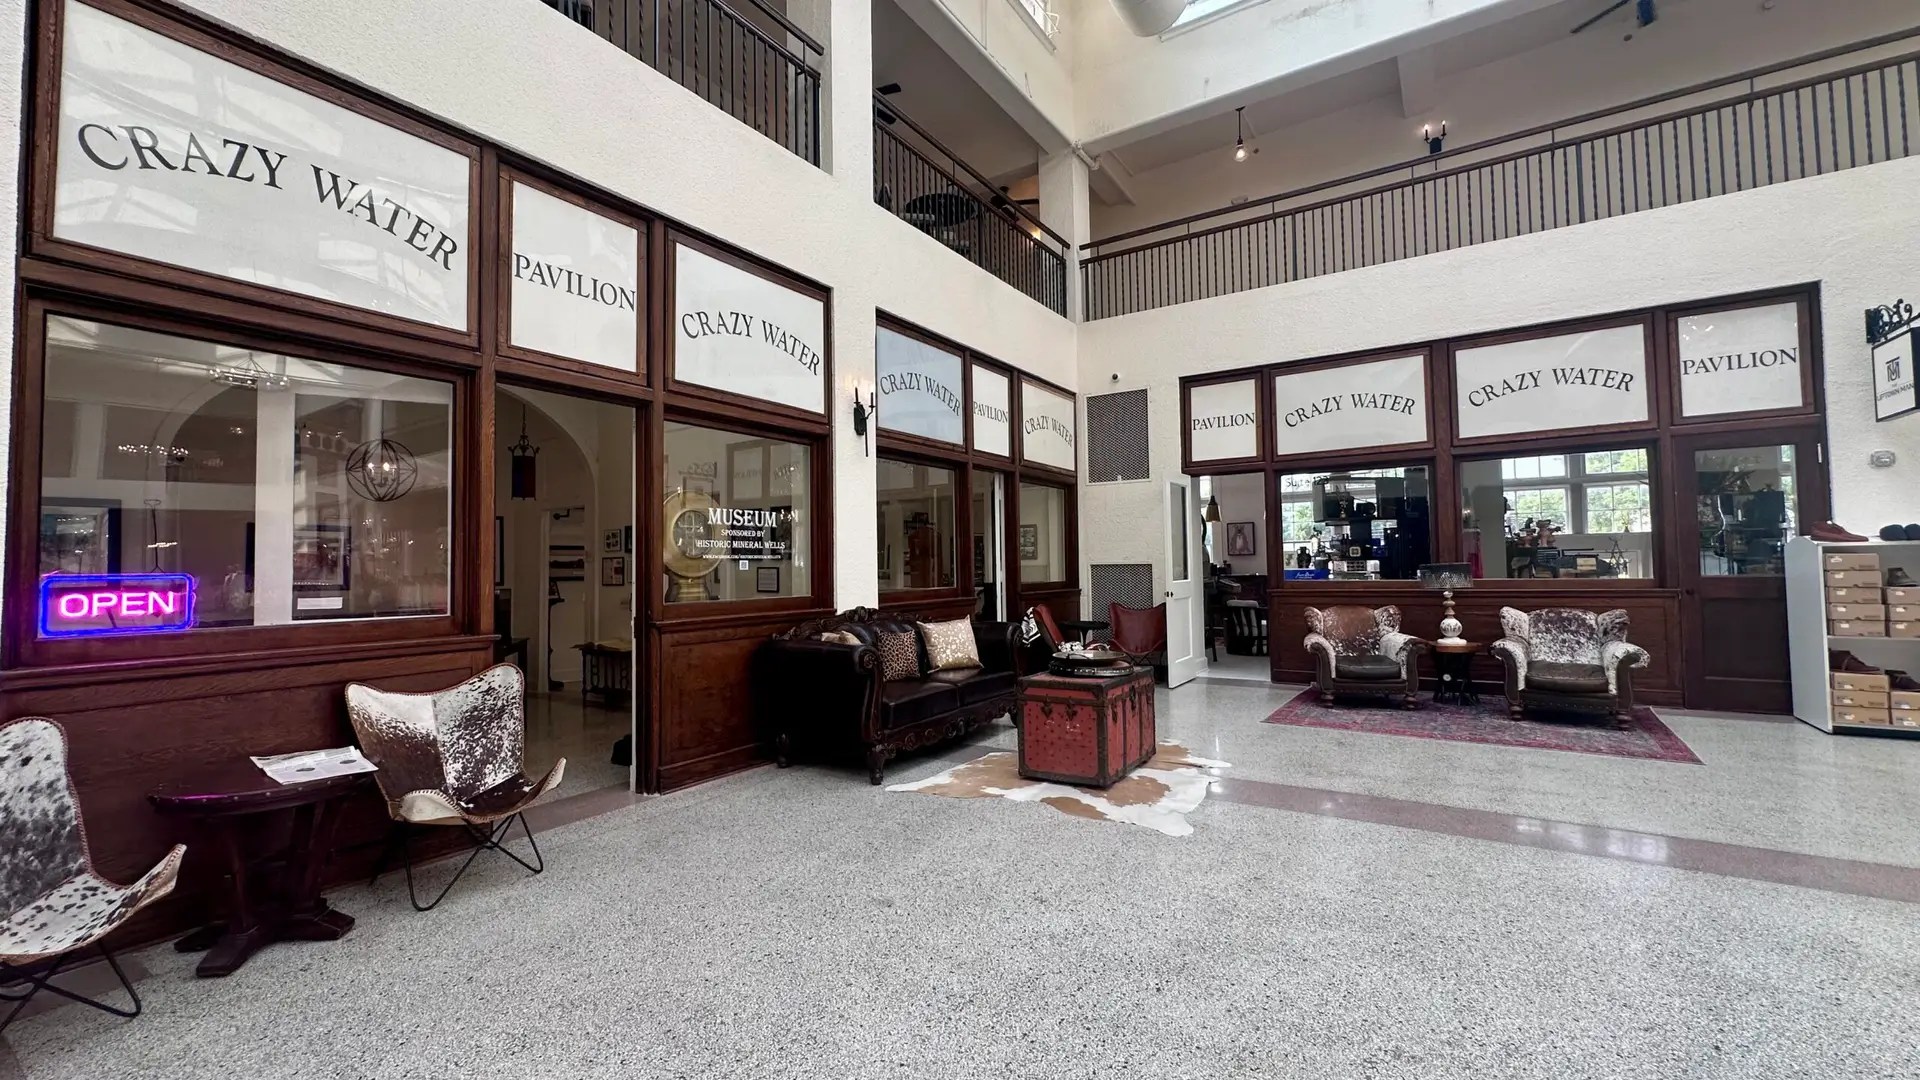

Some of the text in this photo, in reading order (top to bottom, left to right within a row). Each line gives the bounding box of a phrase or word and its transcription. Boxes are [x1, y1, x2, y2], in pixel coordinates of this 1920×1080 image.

[78, 123, 458, 271] CRAZY WATER
[513, 252, 636, 312] PAVILION
[681, 311, 820, 376] CRAZY WATER
[1682, 347, 1798, 376] PAVILION
[880, 372, 961, 416] CRAZY WATER
[1468, 367, 1634, 407] CRAZY WATER
[973, 401, 1008, 424] PAVILION
[1192, 412, 1255, 430] PAVILION
[1285, 392, 1416, 428] CRAZY WATER
[1024, 415, 1073, 448] CRAZY WATER
[707, 507, 777, 527] MUSEUM
[697, 539, 785, 549] HISTORIC MINERAL WELLS
[721, 529, 756, 537] SPONSORED
[60, 591, 175, 617] OPEN
